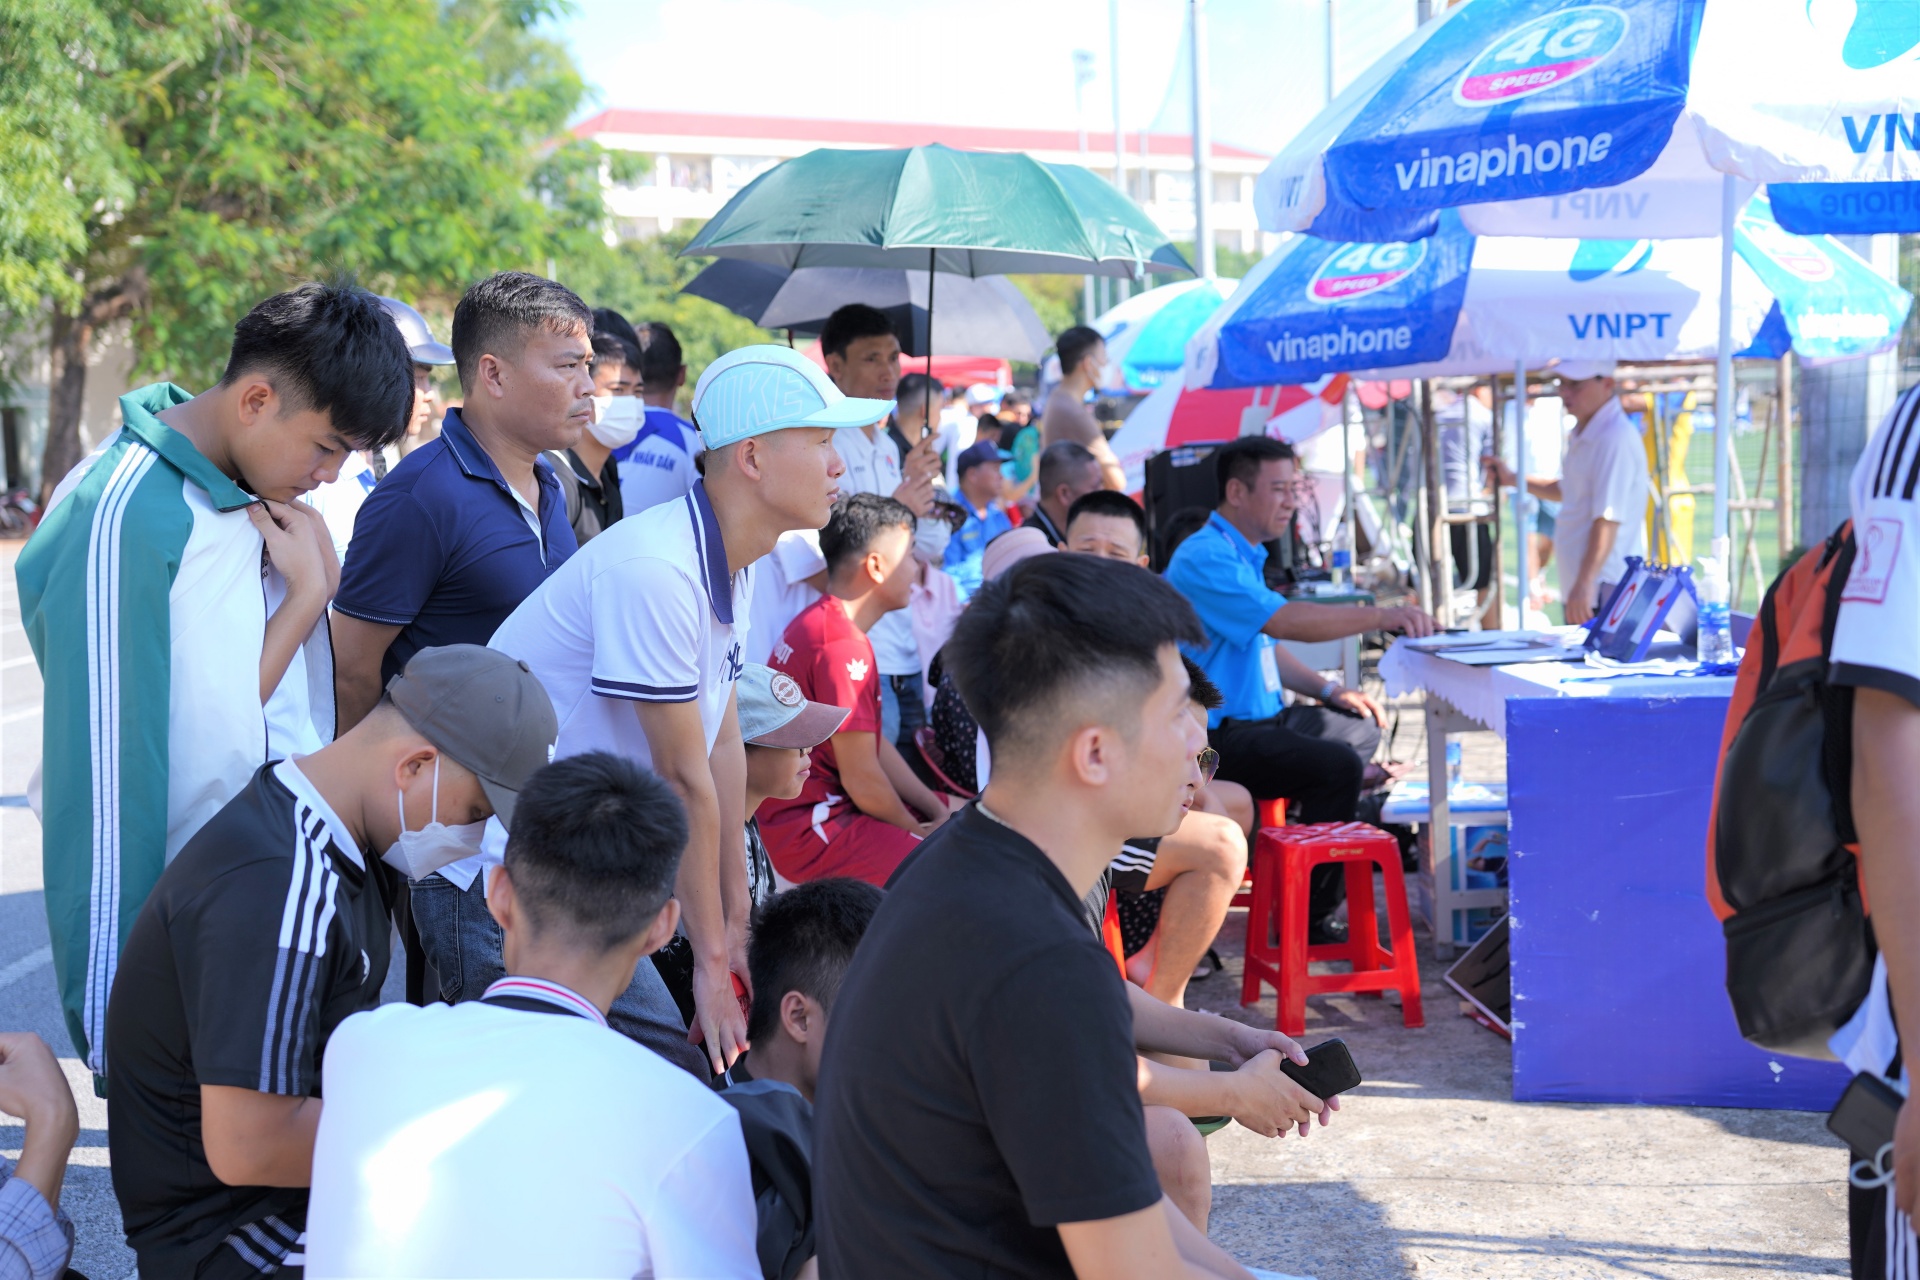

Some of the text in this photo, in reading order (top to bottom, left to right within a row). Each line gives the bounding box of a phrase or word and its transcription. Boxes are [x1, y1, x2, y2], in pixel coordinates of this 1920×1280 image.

[1495, 19, 1604, 64] 4G
[1489, 70, 1557, 91] SPEED
[1395, 131, 1613, 191] vinaphone
[1336, 242, 1408, 271] 4G
[1568, 313, 1671, 339] VNPT
[1266, 325, 1412, 363] vinaphone
